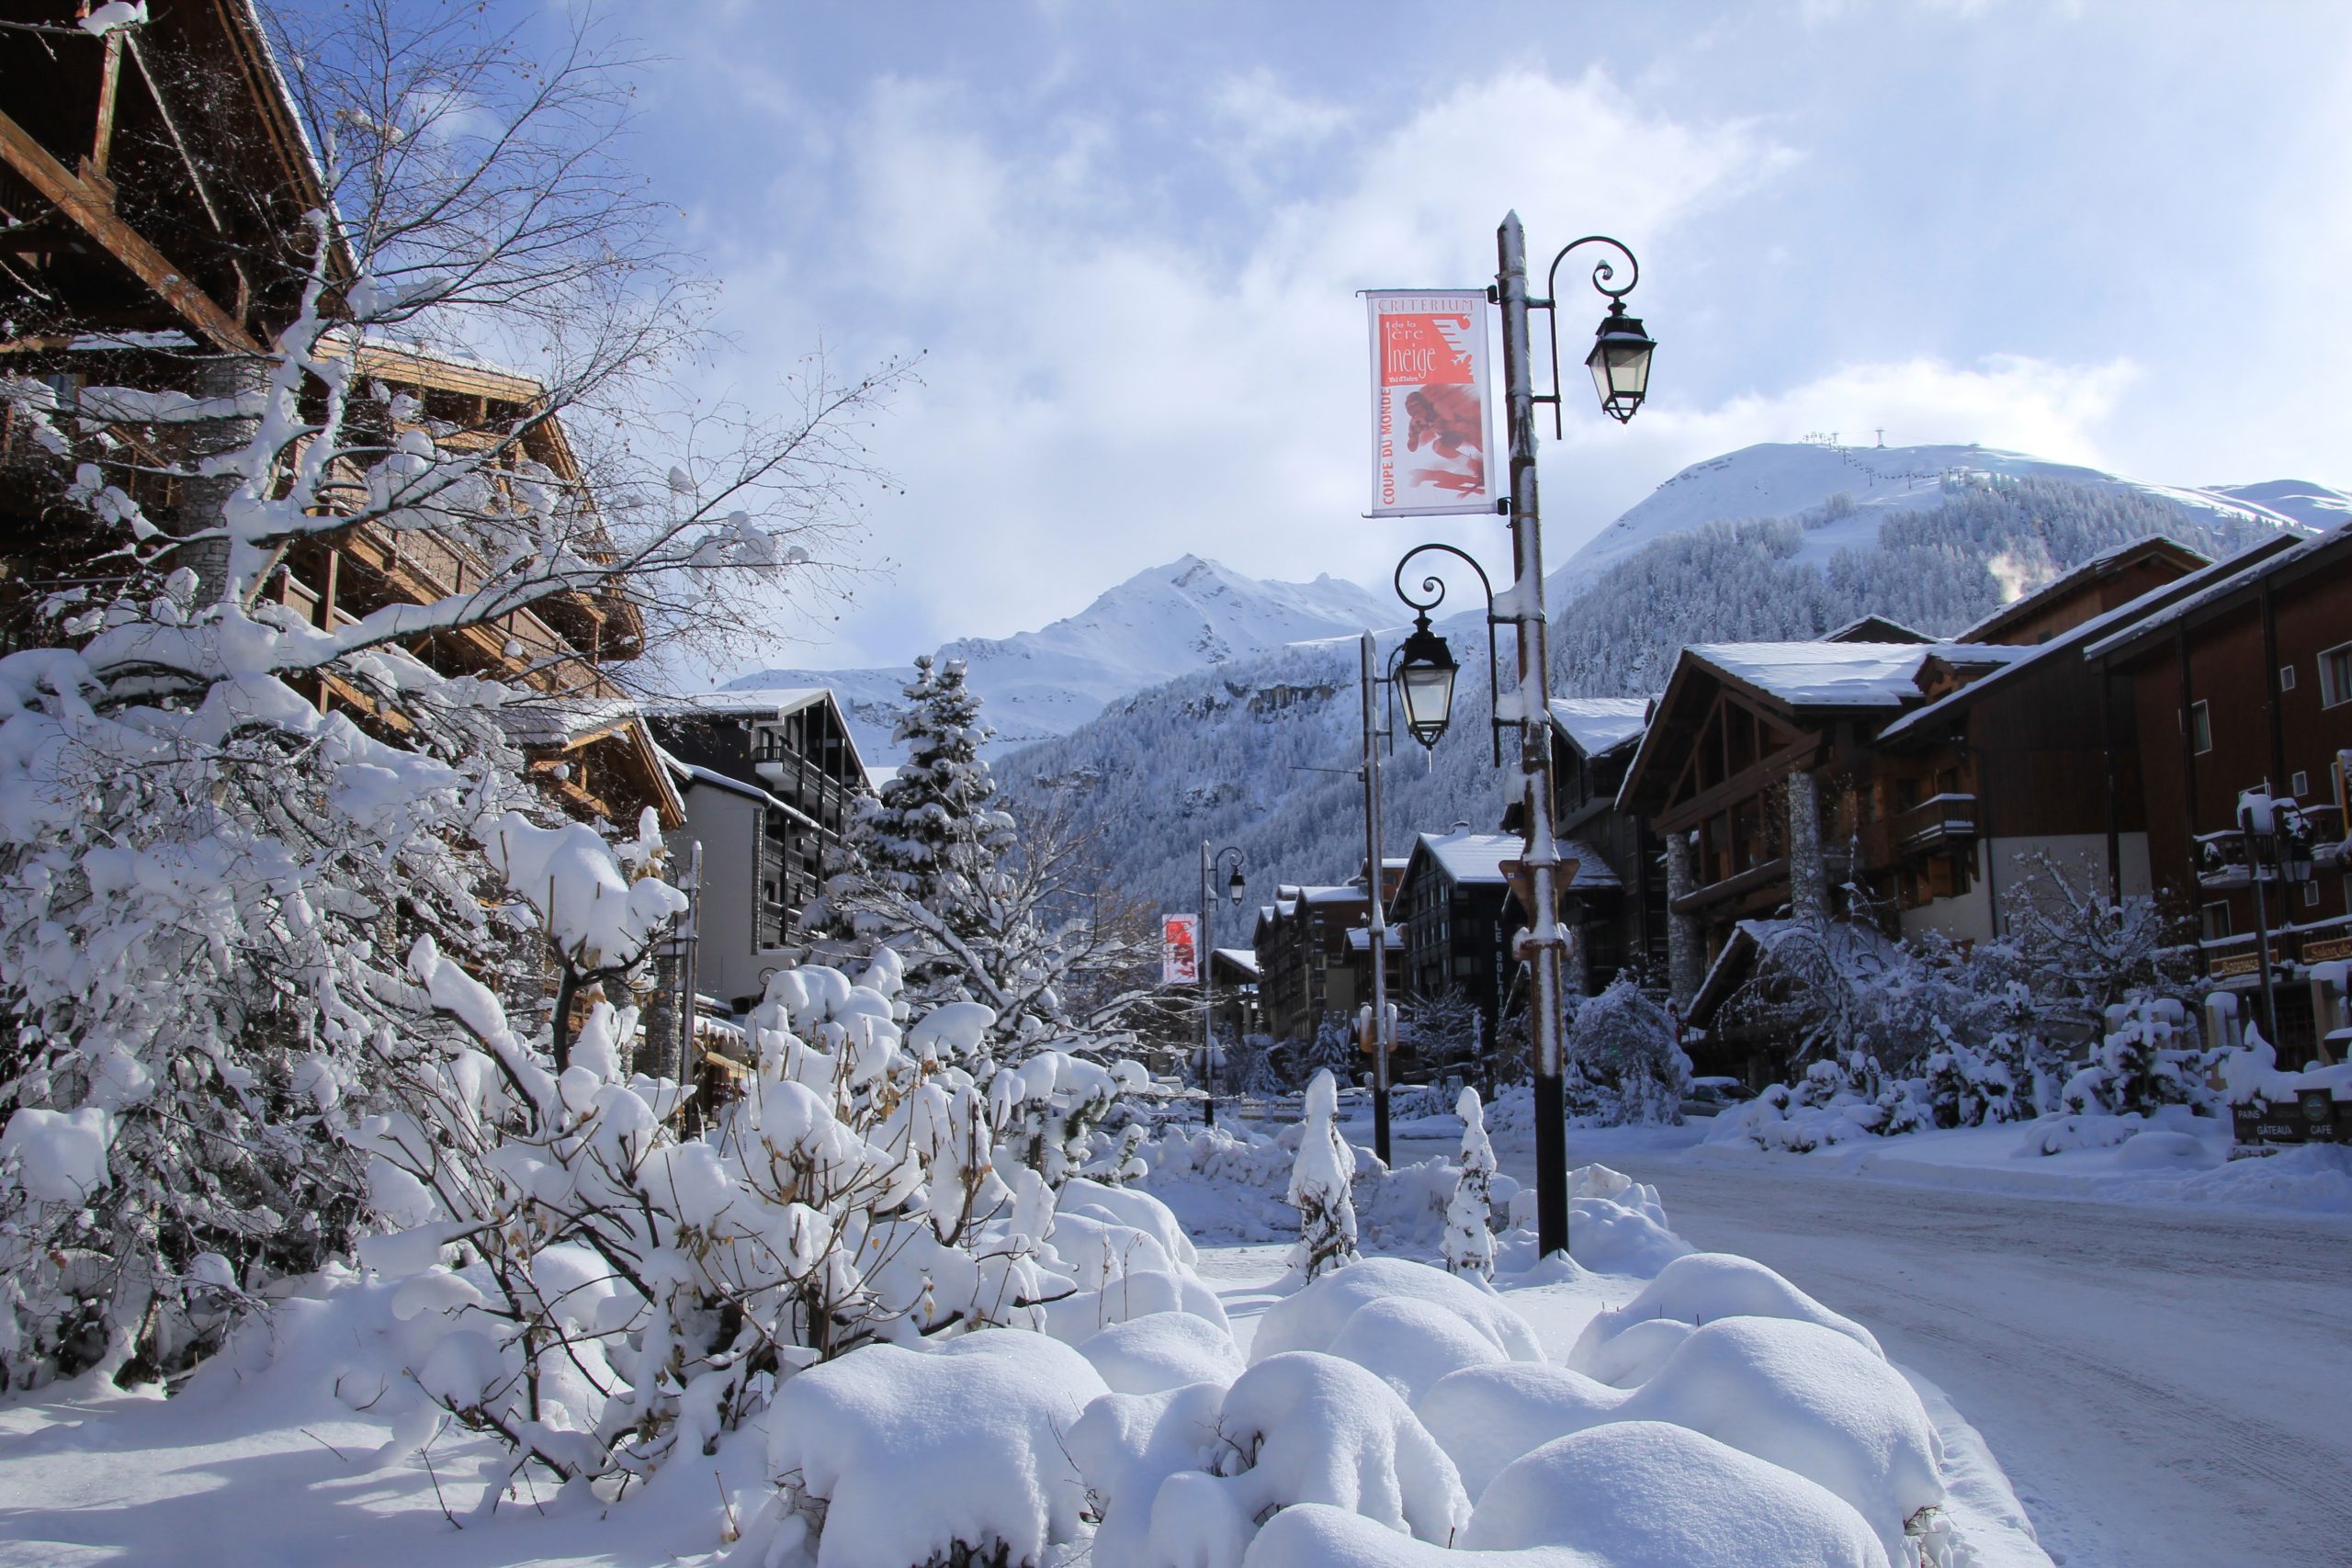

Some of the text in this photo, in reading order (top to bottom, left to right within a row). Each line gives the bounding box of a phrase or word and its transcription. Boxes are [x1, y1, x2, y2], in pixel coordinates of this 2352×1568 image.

[1378, 299, 1474, 311] CRITERIUM
[1393, 343, 1437, 378] neige
[1381, 389, 1396, 505] COUPE DU MONDE
[1494, 919, 1502, 942] LE
[2311, 946, 2337, 958] Salon
[2238, 1111, 2260, 1119] PAINS
